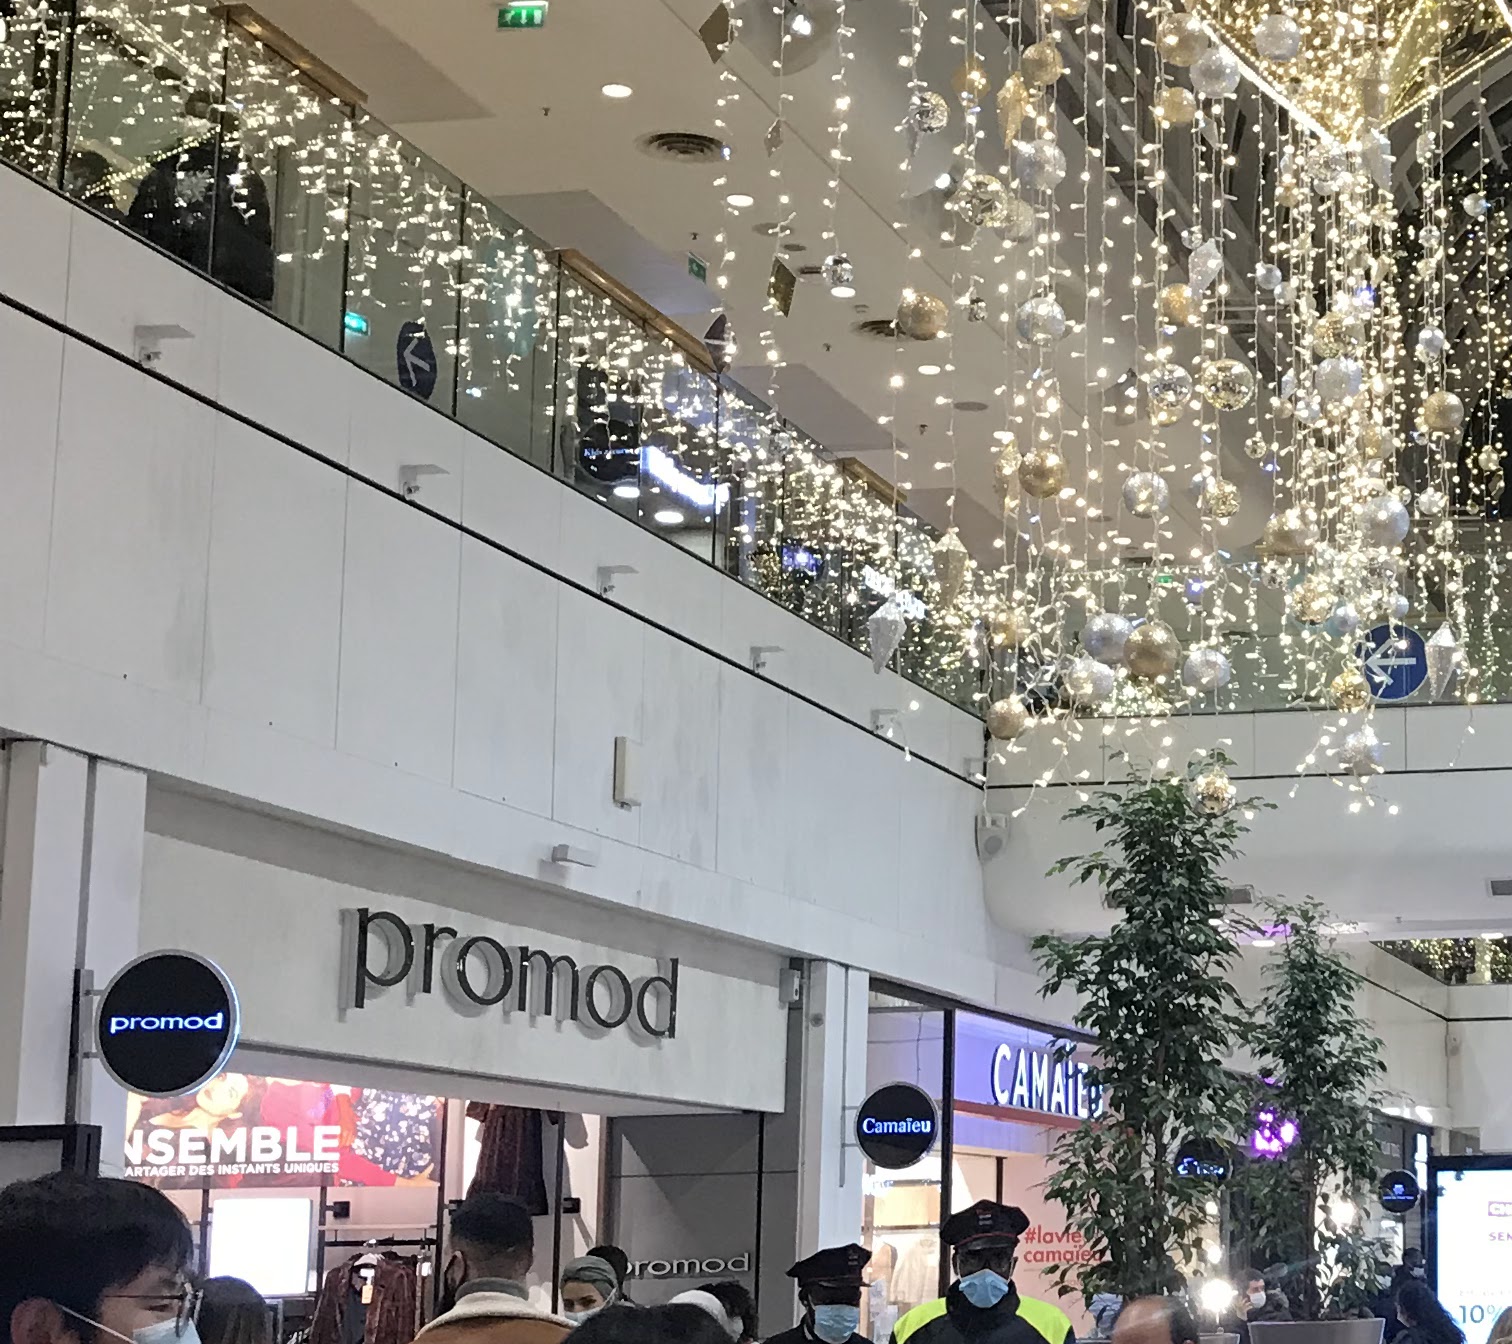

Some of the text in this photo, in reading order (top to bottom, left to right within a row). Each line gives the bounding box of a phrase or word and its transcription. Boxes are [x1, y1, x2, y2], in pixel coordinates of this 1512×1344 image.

[354, 906, 680, 1042] promod
[110, 1012, 223, 1034] promod
[862, 1117, 932, 1134] Camaïeu
[189, 1164, 214, 1176] DES
[218, 1162, 281, 1175] INSTANTS
[284, 1160, 339, 1174] UNIQUES
